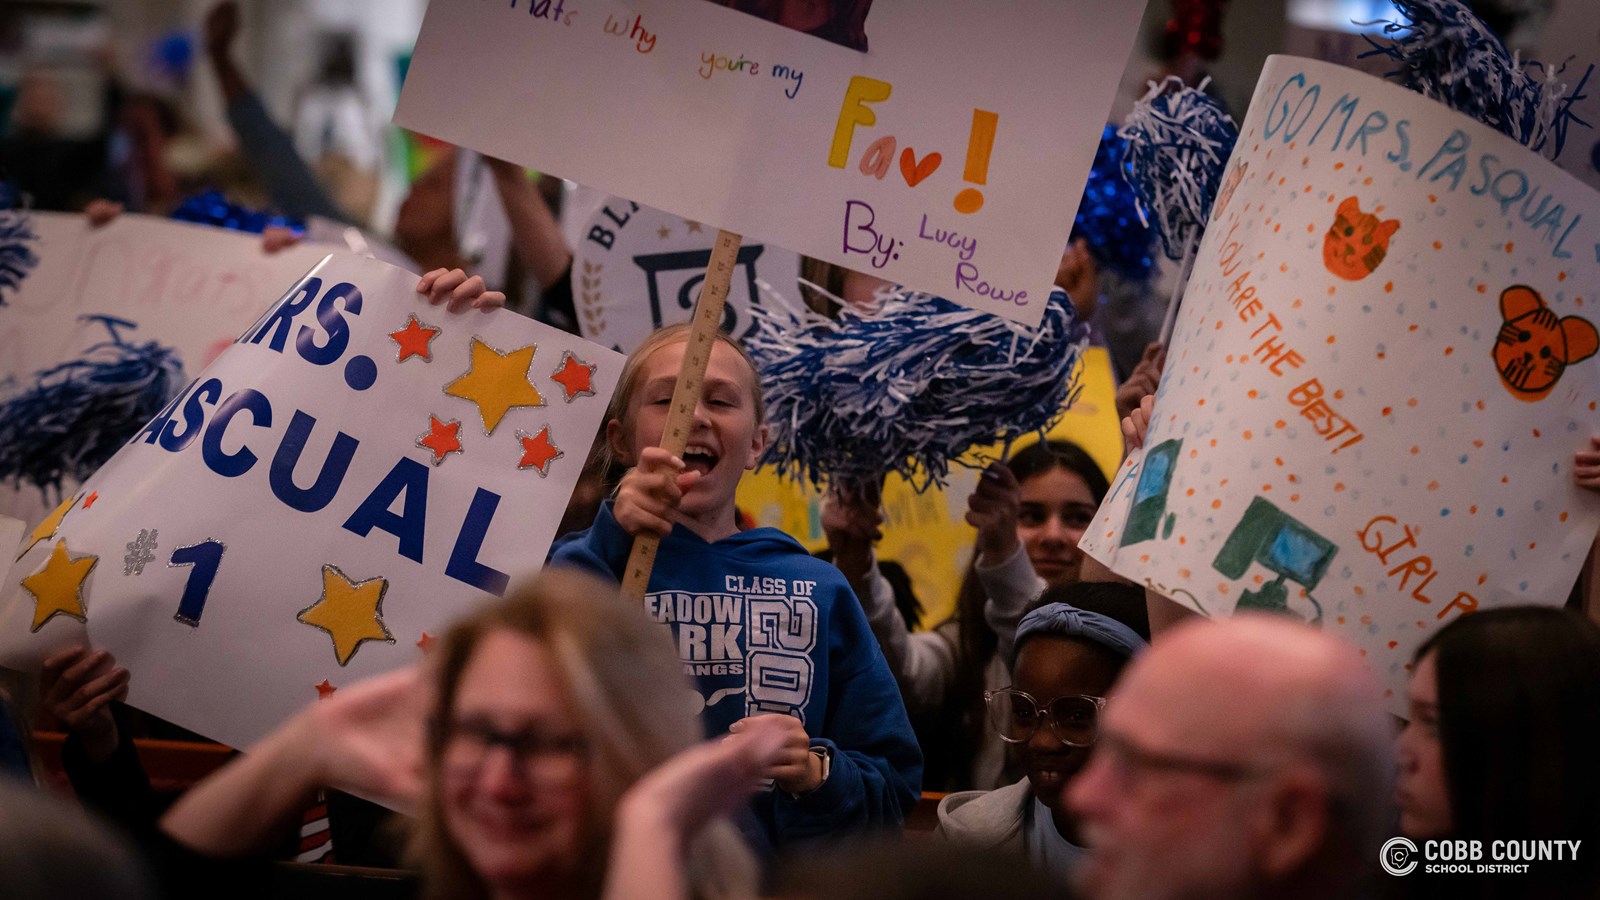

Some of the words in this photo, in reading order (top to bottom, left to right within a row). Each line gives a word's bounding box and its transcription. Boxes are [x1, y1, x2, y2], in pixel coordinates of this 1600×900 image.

[511, 0, 578, 26] ats
[604, 14, 657, 53] why
[699, 49, 759, 79] you're
[772, 64, 803, 99] my
[1264, 72, 1321, 144] GO
[1308, 94, 1412, 172] MRS.
[1416, 129, 1582, 259] PASQUAL
[843, 200, 904, 268] By:
[919, 213, 976, 260] Lucy
[955, 262, 1029, 306] Rowe
[240, 277, 378, 391] RS.
[1226, 271, 1263, 324] ARE
[1250, 312, 1305, 377] THE
[1287, 378, 1364, 454] BEST!
[130, 377, 511, 599] ASCUAL
[644, 592, 743, 625] EADOW
[725, 575, 787, 594] CLASS
[793, 580, 817, 596] OF
[1356, 515, 1438, 604] GIRL
[1437, 592, 1479, 620] P
[679, 623, 743, 662] RK
[686, 664, 744, 676] ANGS
